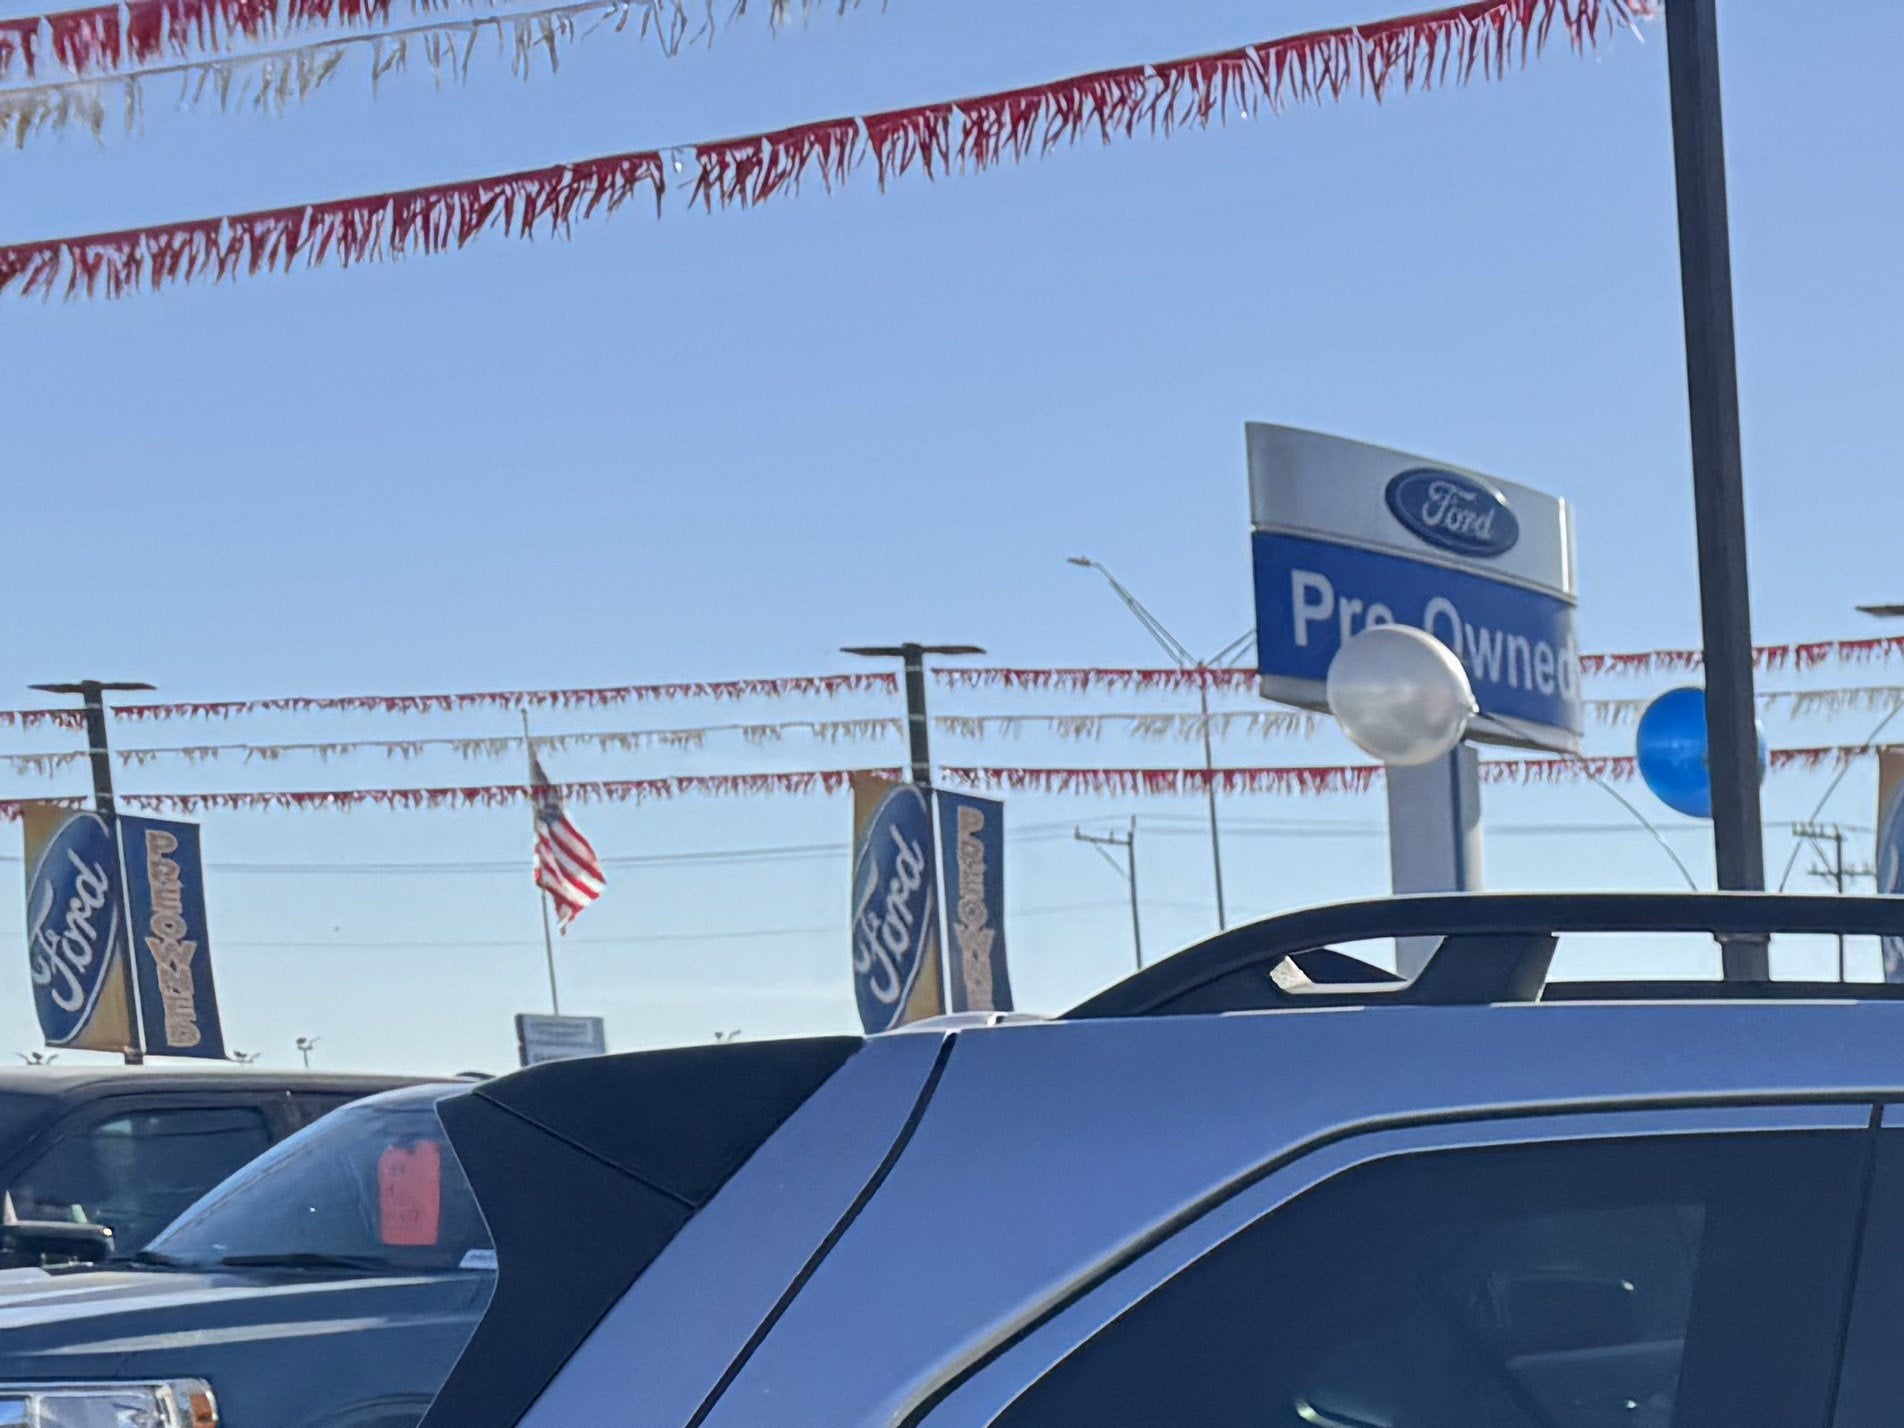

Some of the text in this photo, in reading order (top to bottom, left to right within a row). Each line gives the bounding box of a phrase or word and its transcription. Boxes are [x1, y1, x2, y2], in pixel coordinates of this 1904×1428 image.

[1422, 481, 1494, 542] Ford
[1291, 568, 1579, 703] PrOwned
[31, 848, 109, 1012] Ford
[854, 823, 924, 1004] Ford
[955, 804, 995, 1011] PREOWNE
